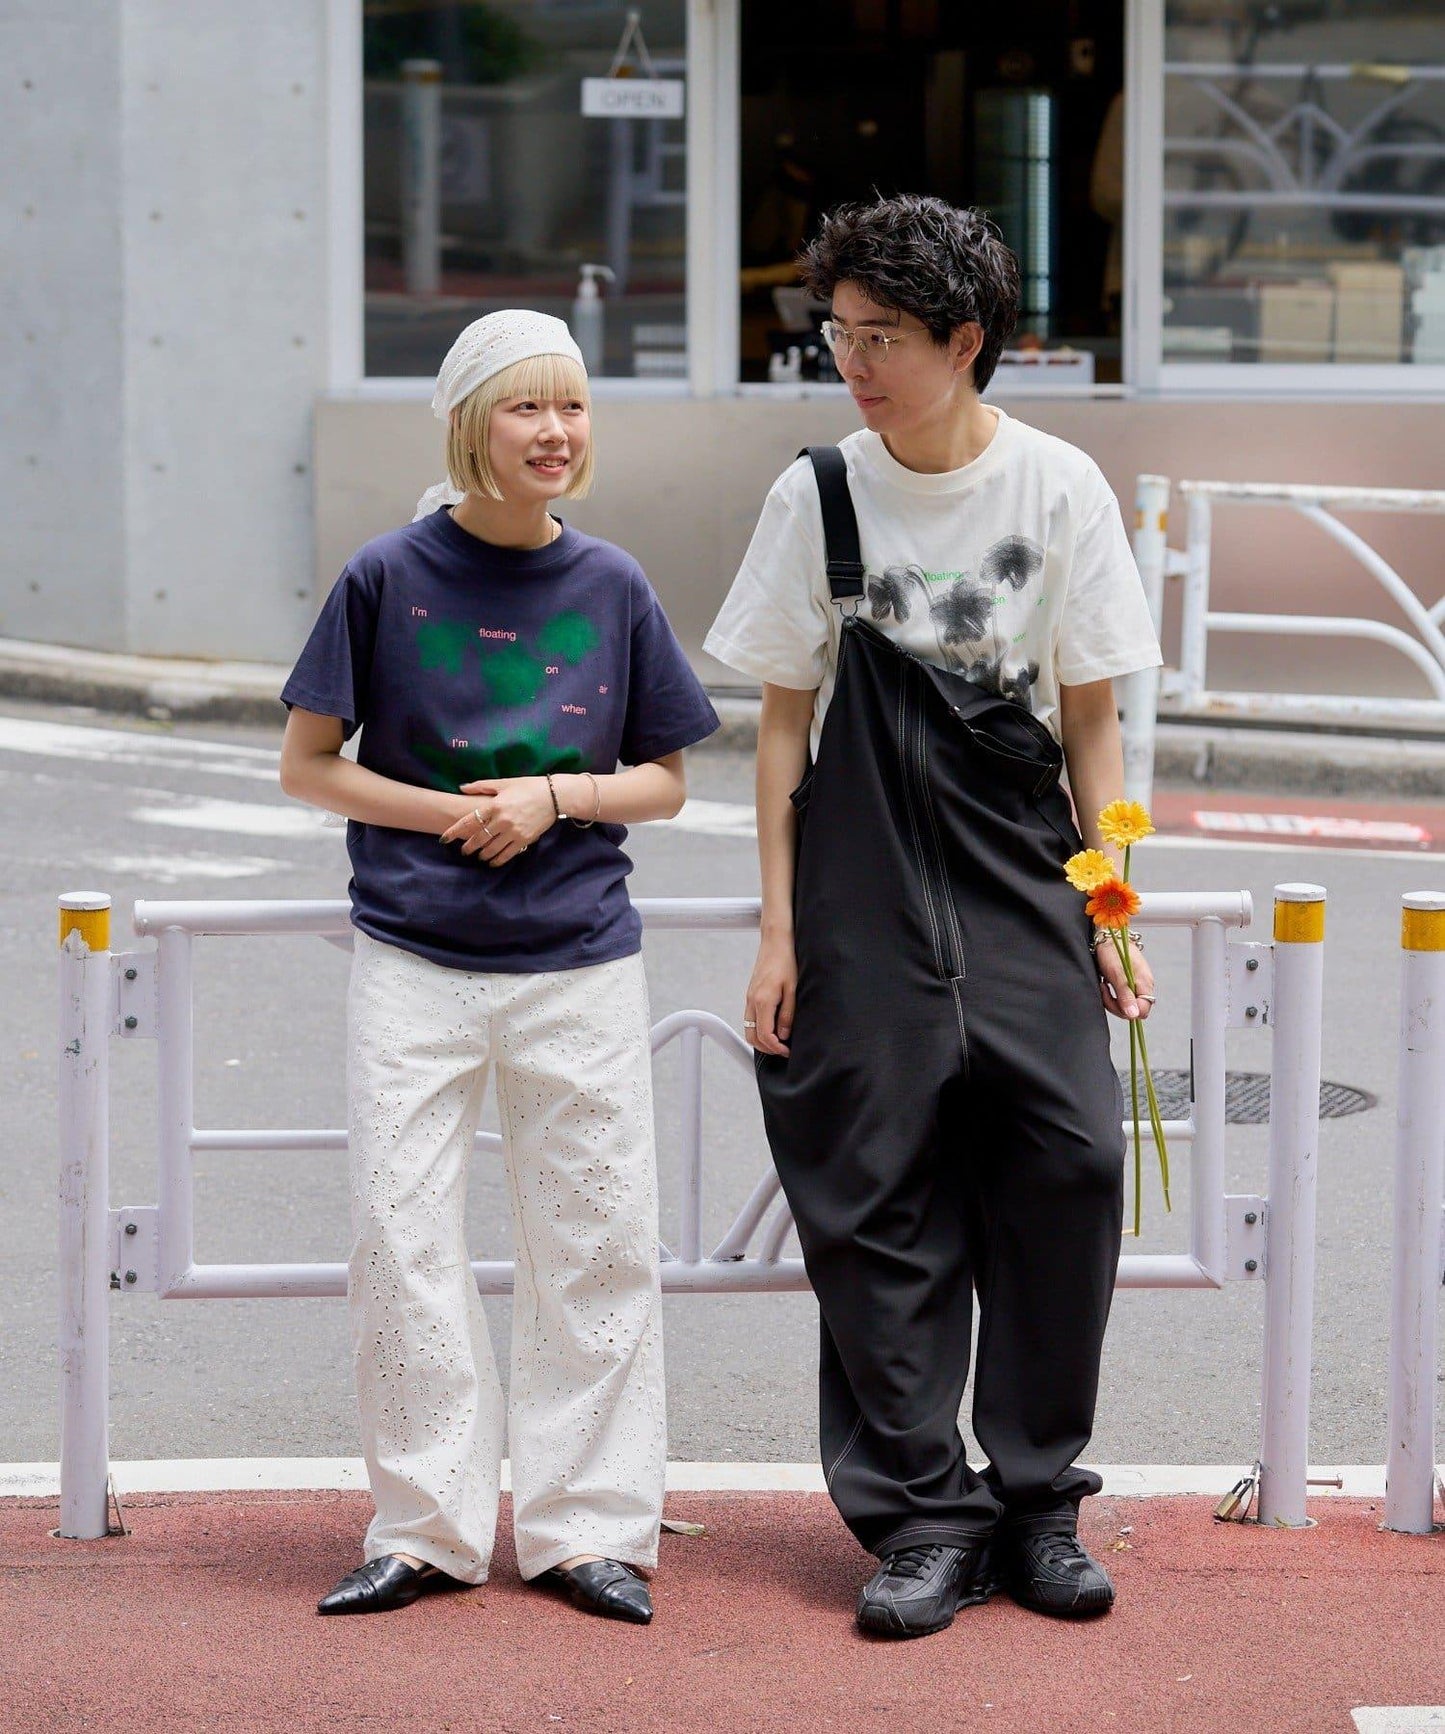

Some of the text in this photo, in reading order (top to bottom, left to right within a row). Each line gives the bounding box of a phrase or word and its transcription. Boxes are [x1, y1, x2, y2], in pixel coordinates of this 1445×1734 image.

[601, 90, 666, 108] OPEN
[411, 606, 427, 617] I'm
[479, 627, 516, 641] floating
[545, 665, 559, 675] on
[561, 703, 587, 716] when
[452, 738, 468, 748] I'm
